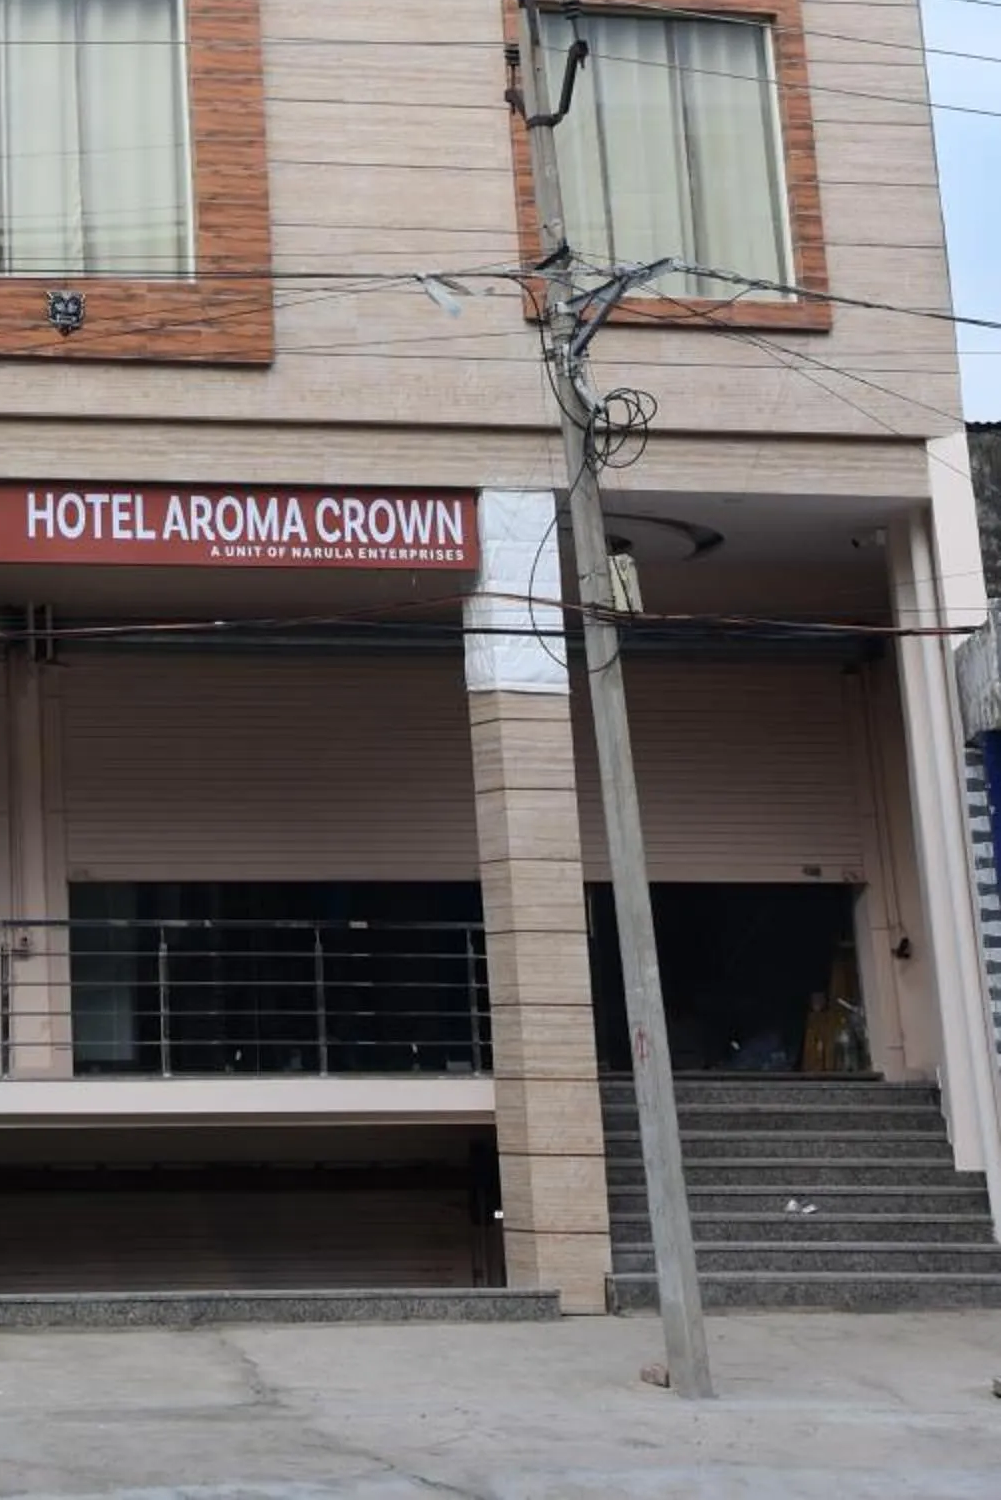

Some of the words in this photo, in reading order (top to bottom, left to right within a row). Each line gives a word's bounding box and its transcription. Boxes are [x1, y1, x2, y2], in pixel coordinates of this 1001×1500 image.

[27, 492, 157, 540] HOTEL
[162, 495, 308, 542] AROMA
[315, 497, 464, 544] CROWN
[210, 546, 221, 557] A
[225, 546, 262, 558] UNIT
[267, 547, 286, 559] OF
[291, 547, 354, 560] NARULA
[358, 548, 465, 561] ENTERPRISES
